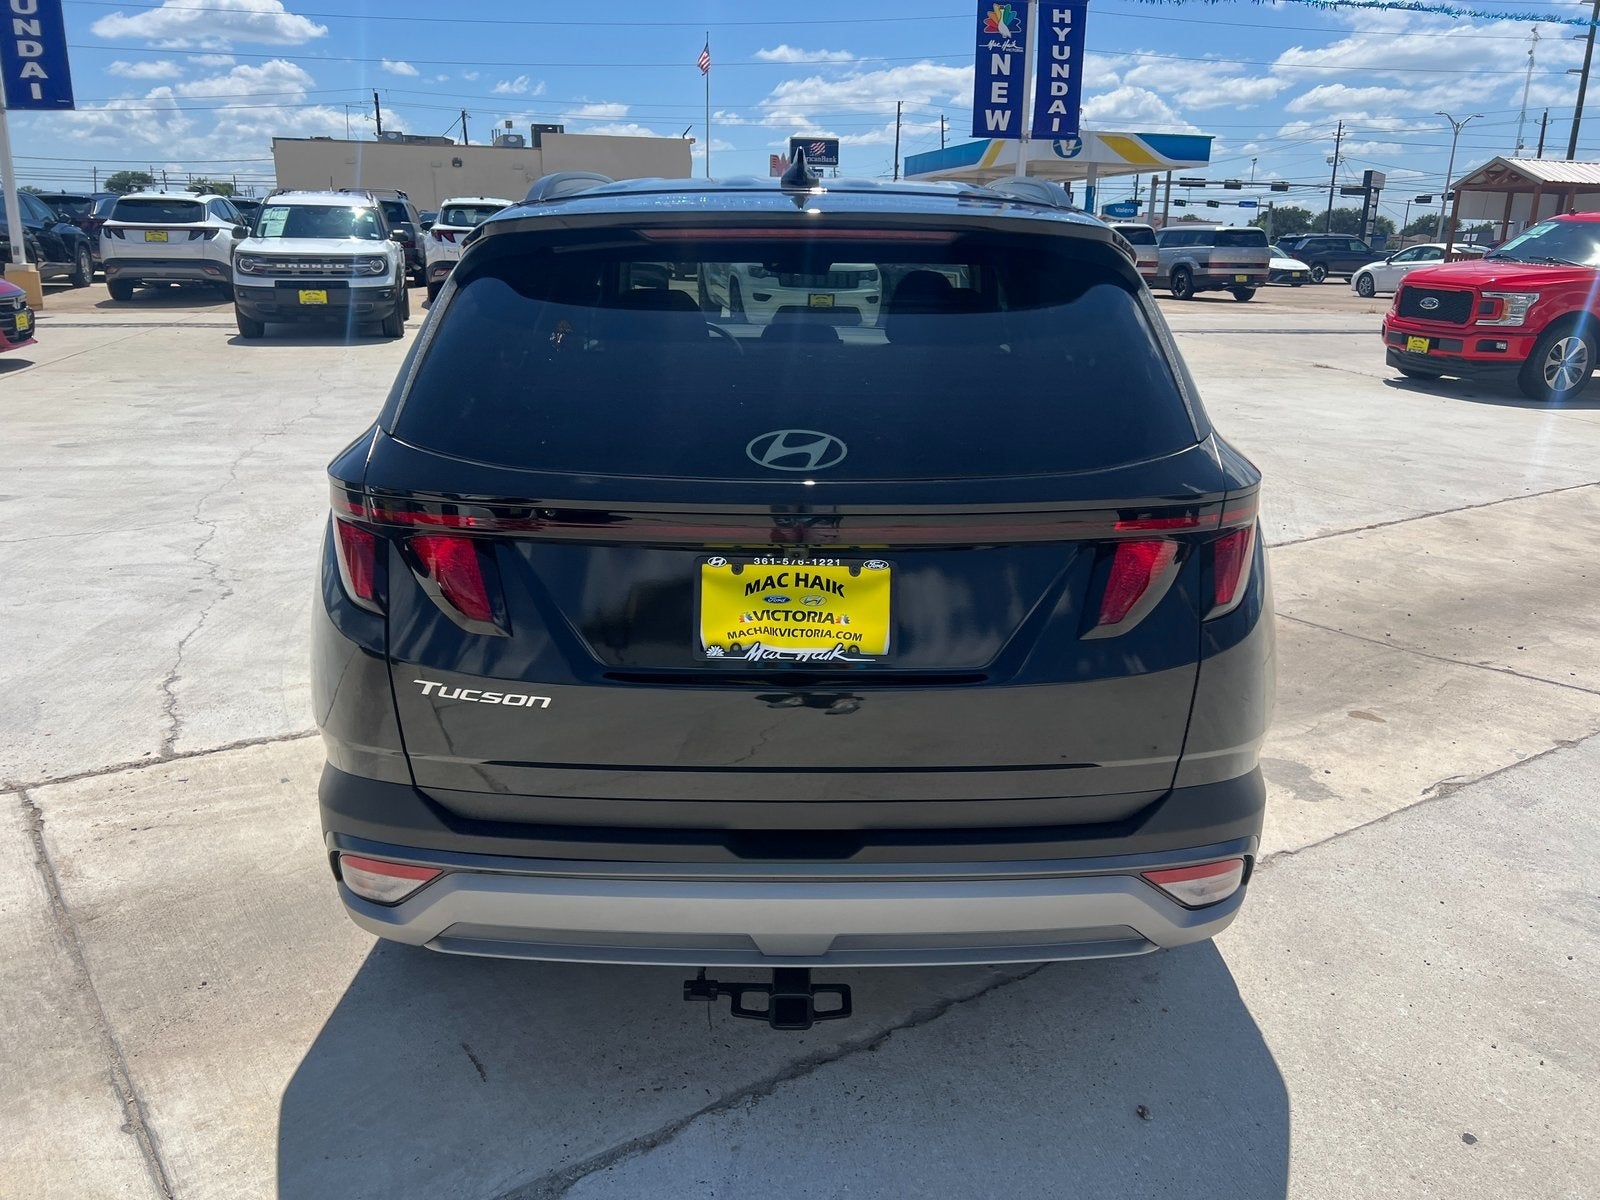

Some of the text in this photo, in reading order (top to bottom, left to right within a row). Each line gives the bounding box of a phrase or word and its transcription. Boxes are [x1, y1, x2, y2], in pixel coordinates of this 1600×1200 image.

[1047, 9, 1071, 132] HYUNDAI
[985, 53, 1011, 131] NEW
[753, 557, 841, 566] 361-576-1221
[744, 572, 846, 598] MAC HAIK
[752, 609, 836, 625] VICTORIA
[726, 626, 864, 642] MACHAIKVICTORIA.COM
